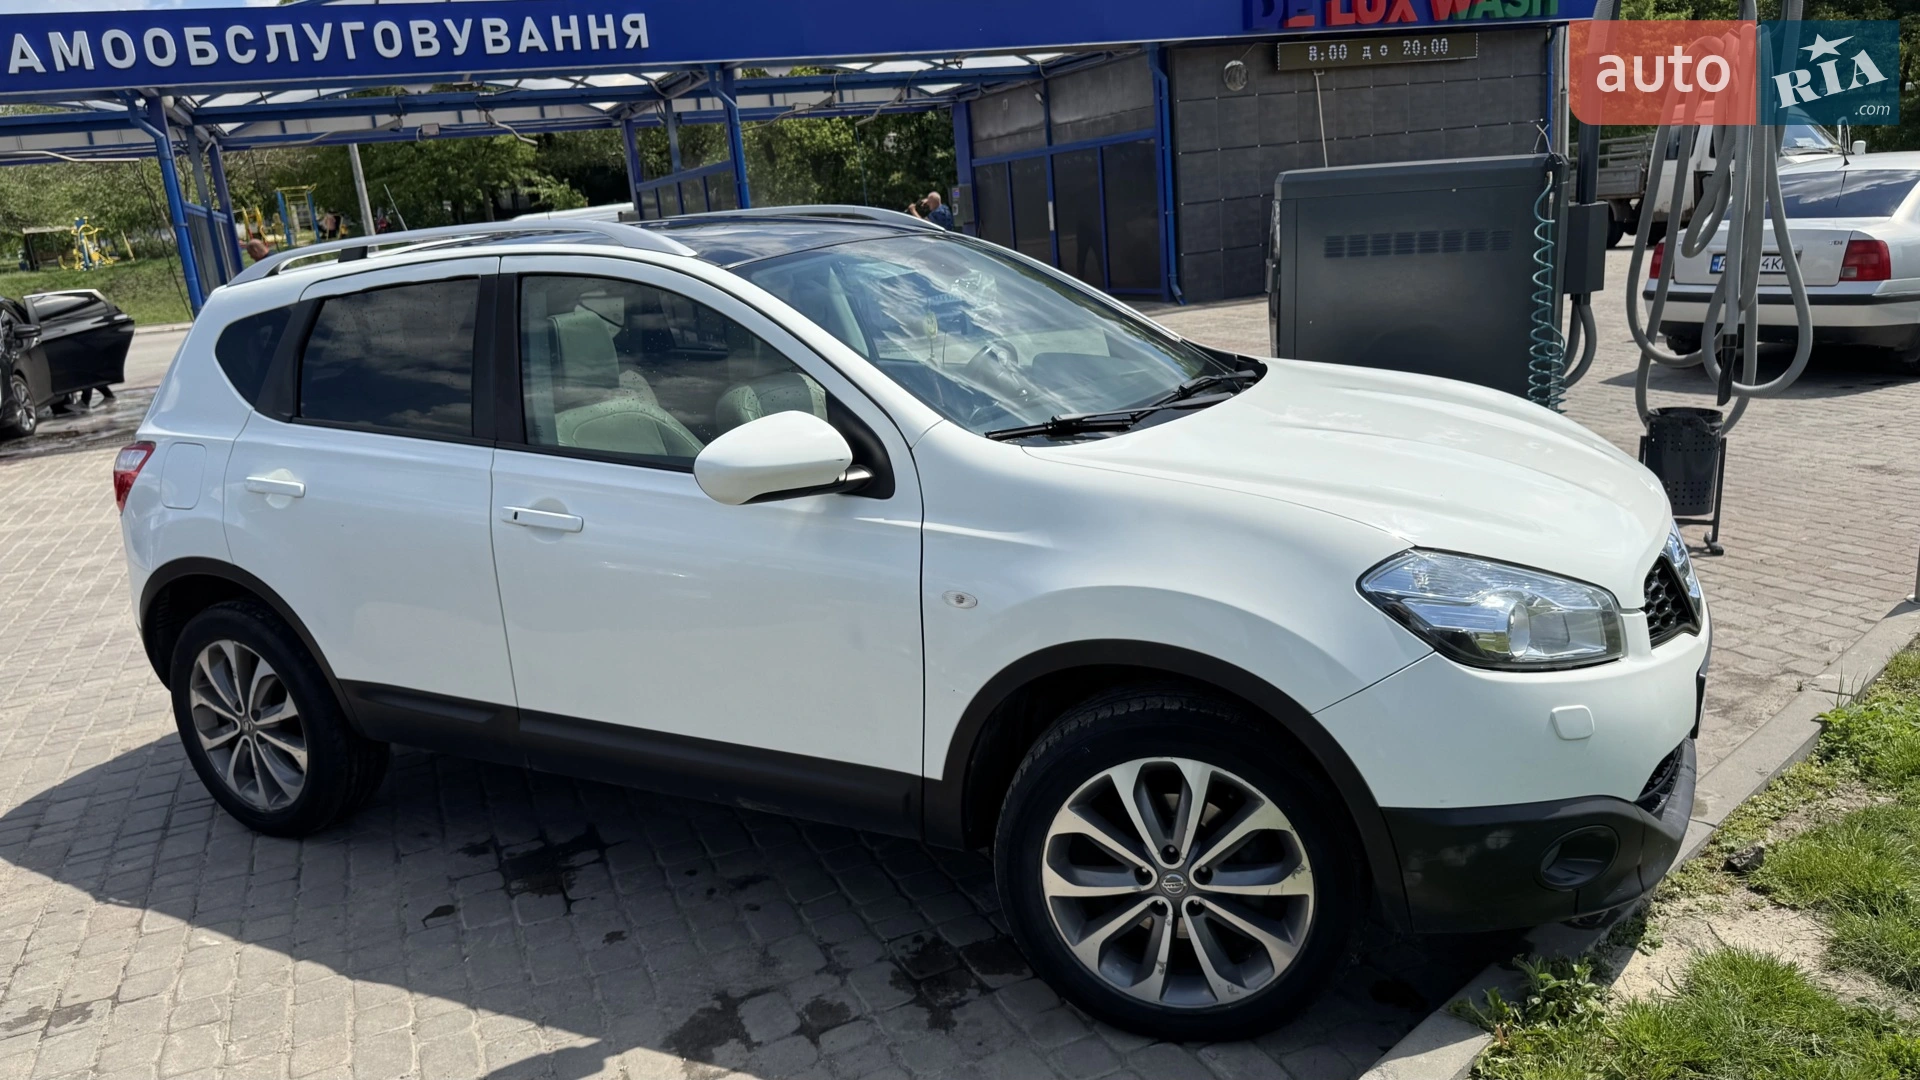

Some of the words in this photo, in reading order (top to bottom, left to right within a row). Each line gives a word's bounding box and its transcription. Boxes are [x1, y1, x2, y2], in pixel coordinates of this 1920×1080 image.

[1326, 0, 1418, 27] LUX
[1308, 43, 1348, 62] 8:00
[1402, 37, 1449, 56] 20:00
